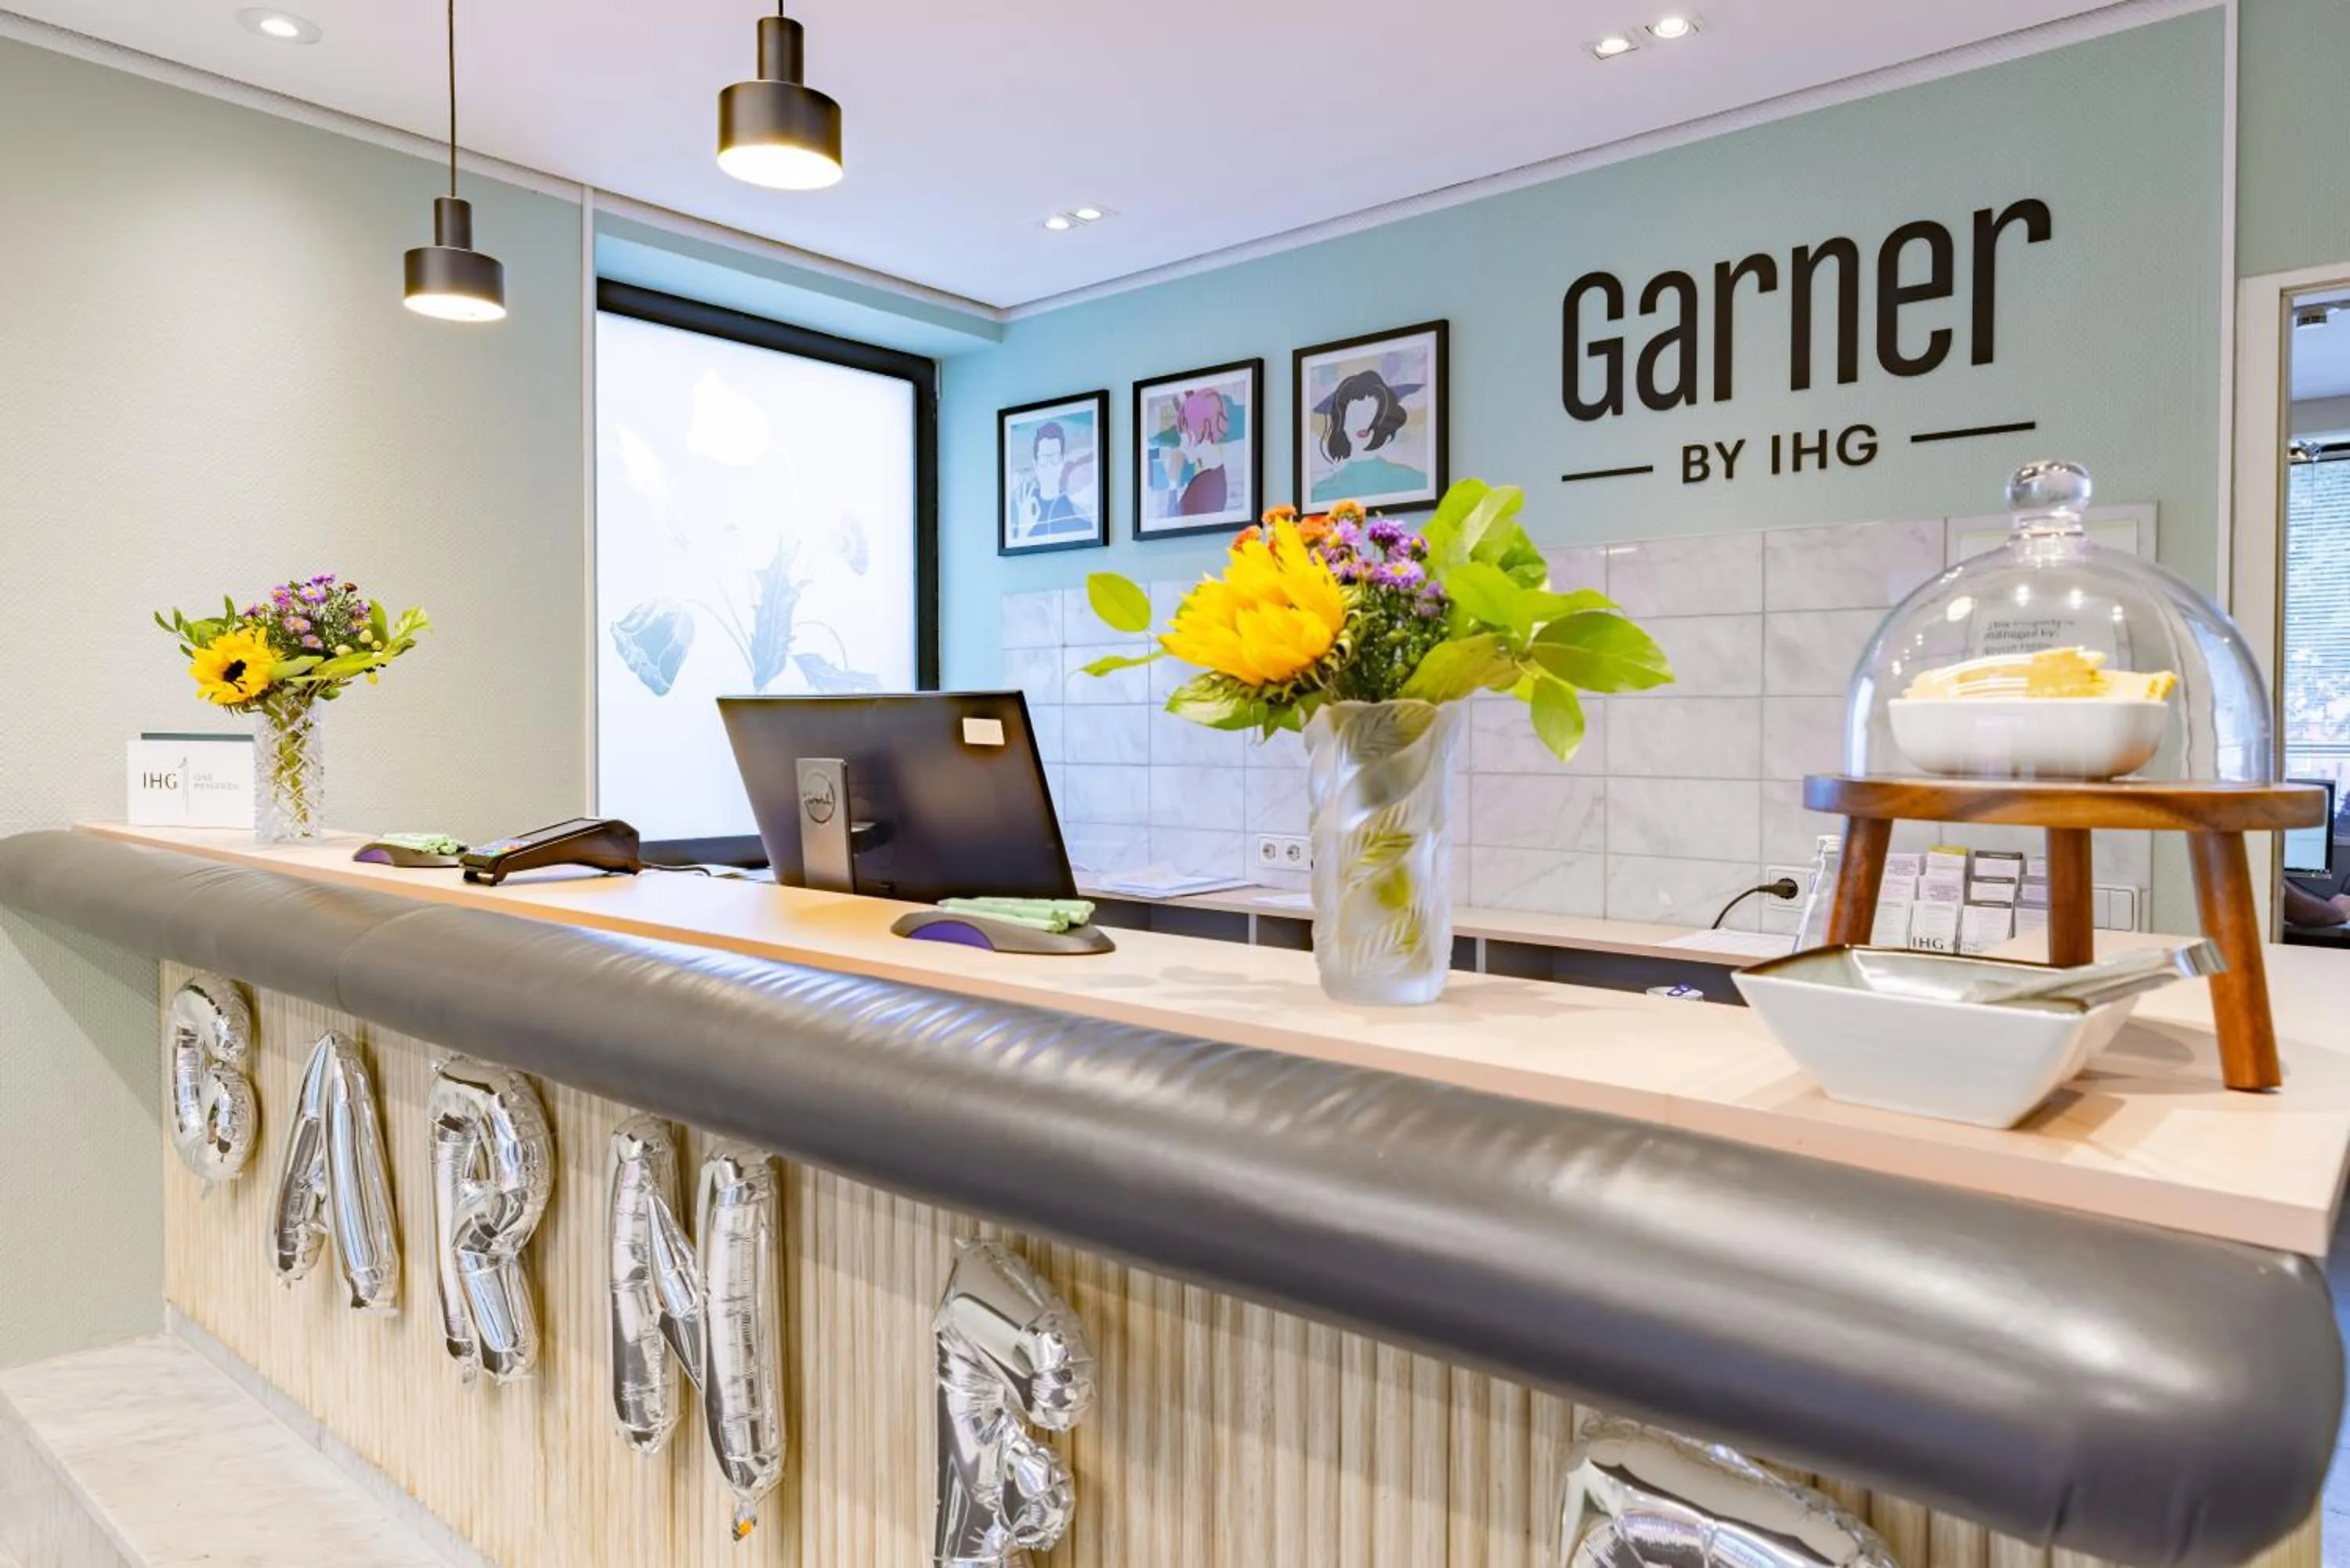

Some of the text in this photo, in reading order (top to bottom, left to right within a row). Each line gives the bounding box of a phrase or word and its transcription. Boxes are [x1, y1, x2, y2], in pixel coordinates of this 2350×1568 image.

[1561, 197, 2052, 421] Garner
[1682, 424, 1878, 484] BY IHG
[143, 771, 178, 790] IHG
[1912, 936, 1944, 950] IHG
